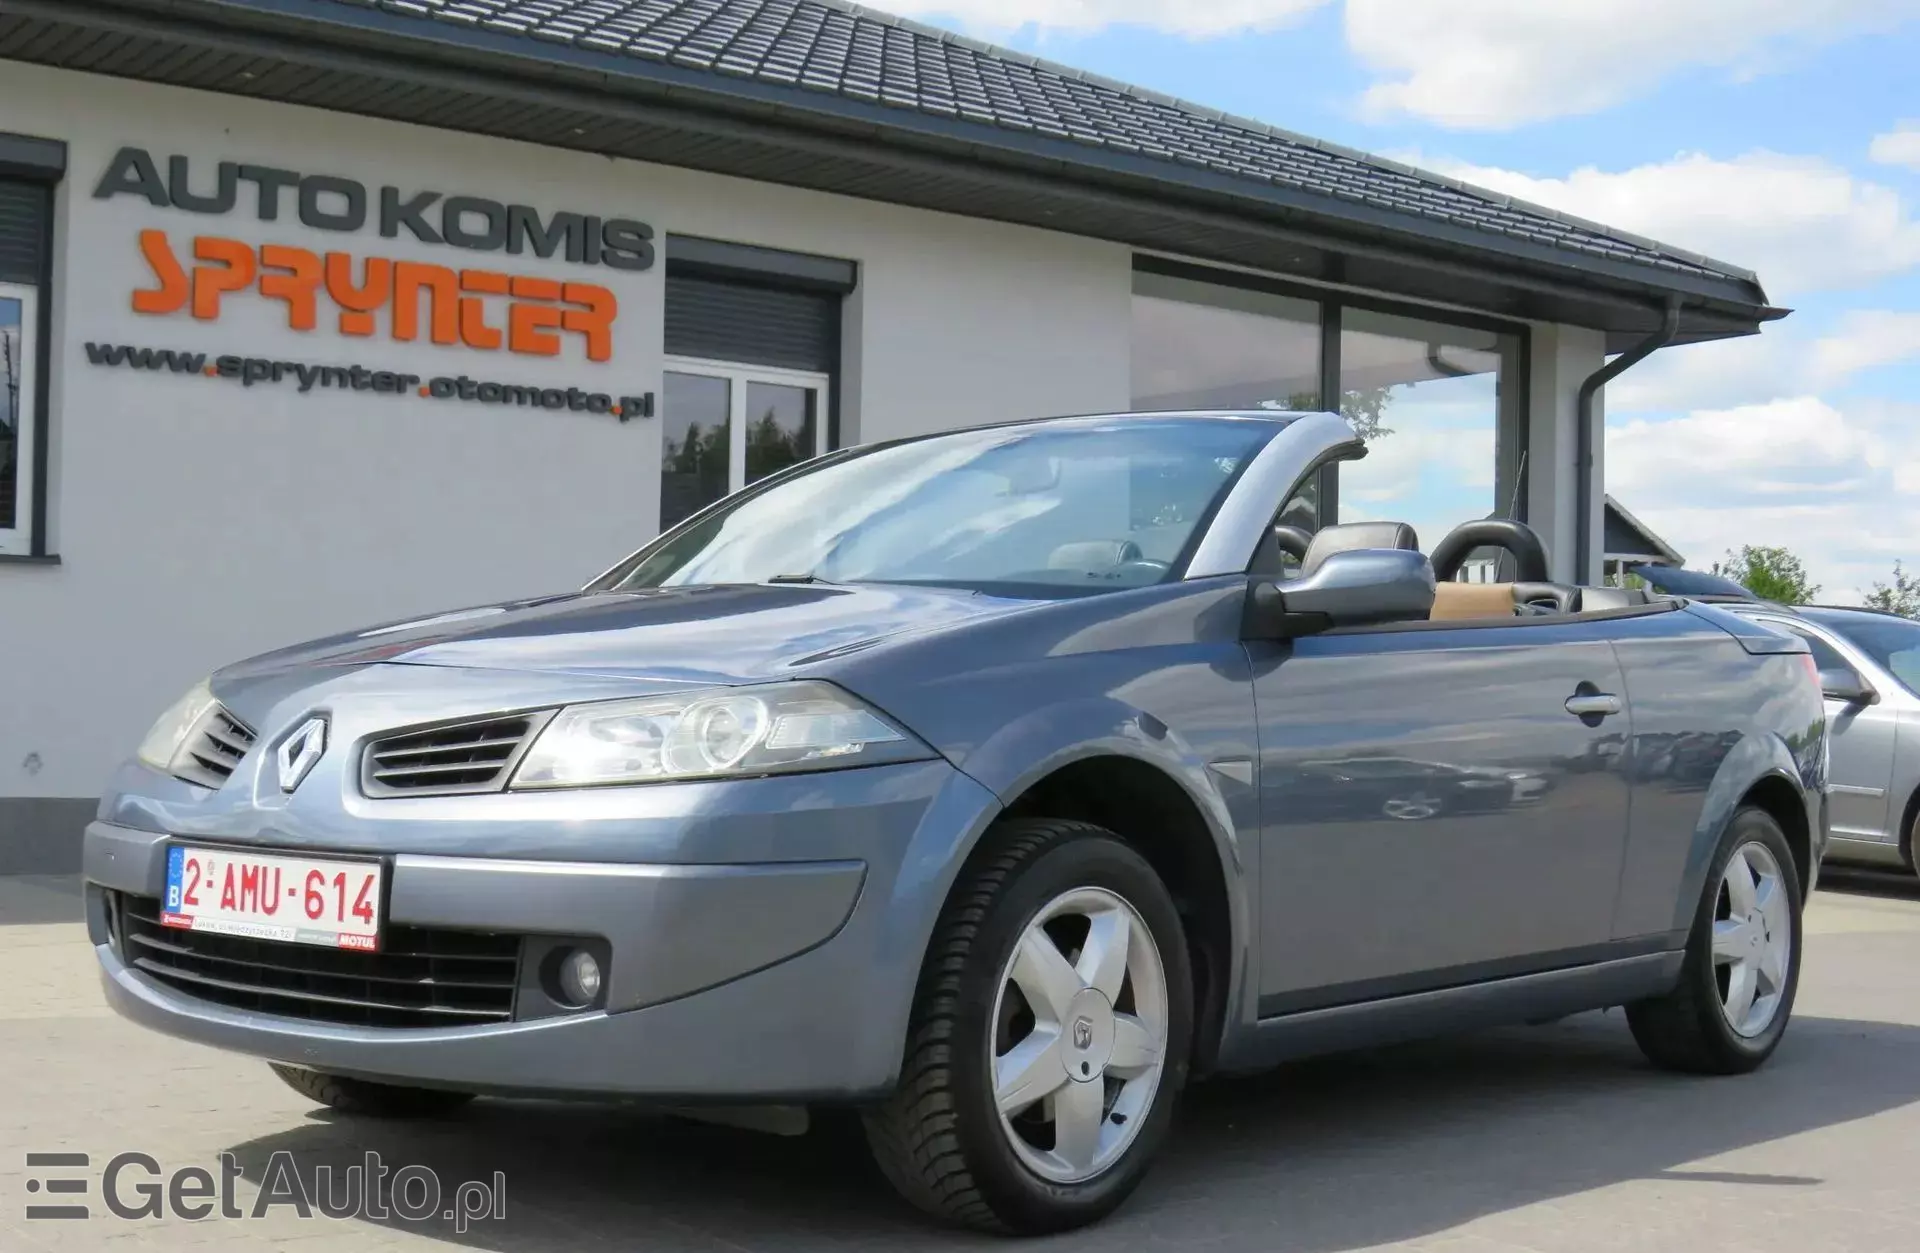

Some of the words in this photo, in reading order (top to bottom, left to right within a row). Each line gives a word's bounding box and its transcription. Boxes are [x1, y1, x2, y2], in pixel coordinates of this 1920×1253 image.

[92, 147, 366, 231] AUTO
[380, 185, 655, 270] KOMIS
[131, 228, 617, 362] SPRYNTER
[84, 342, 655, 422] www.sprynter.otomoto.pl
[168, 885, 180, 907] B
[339, 935, 375, 949] MOTUL
